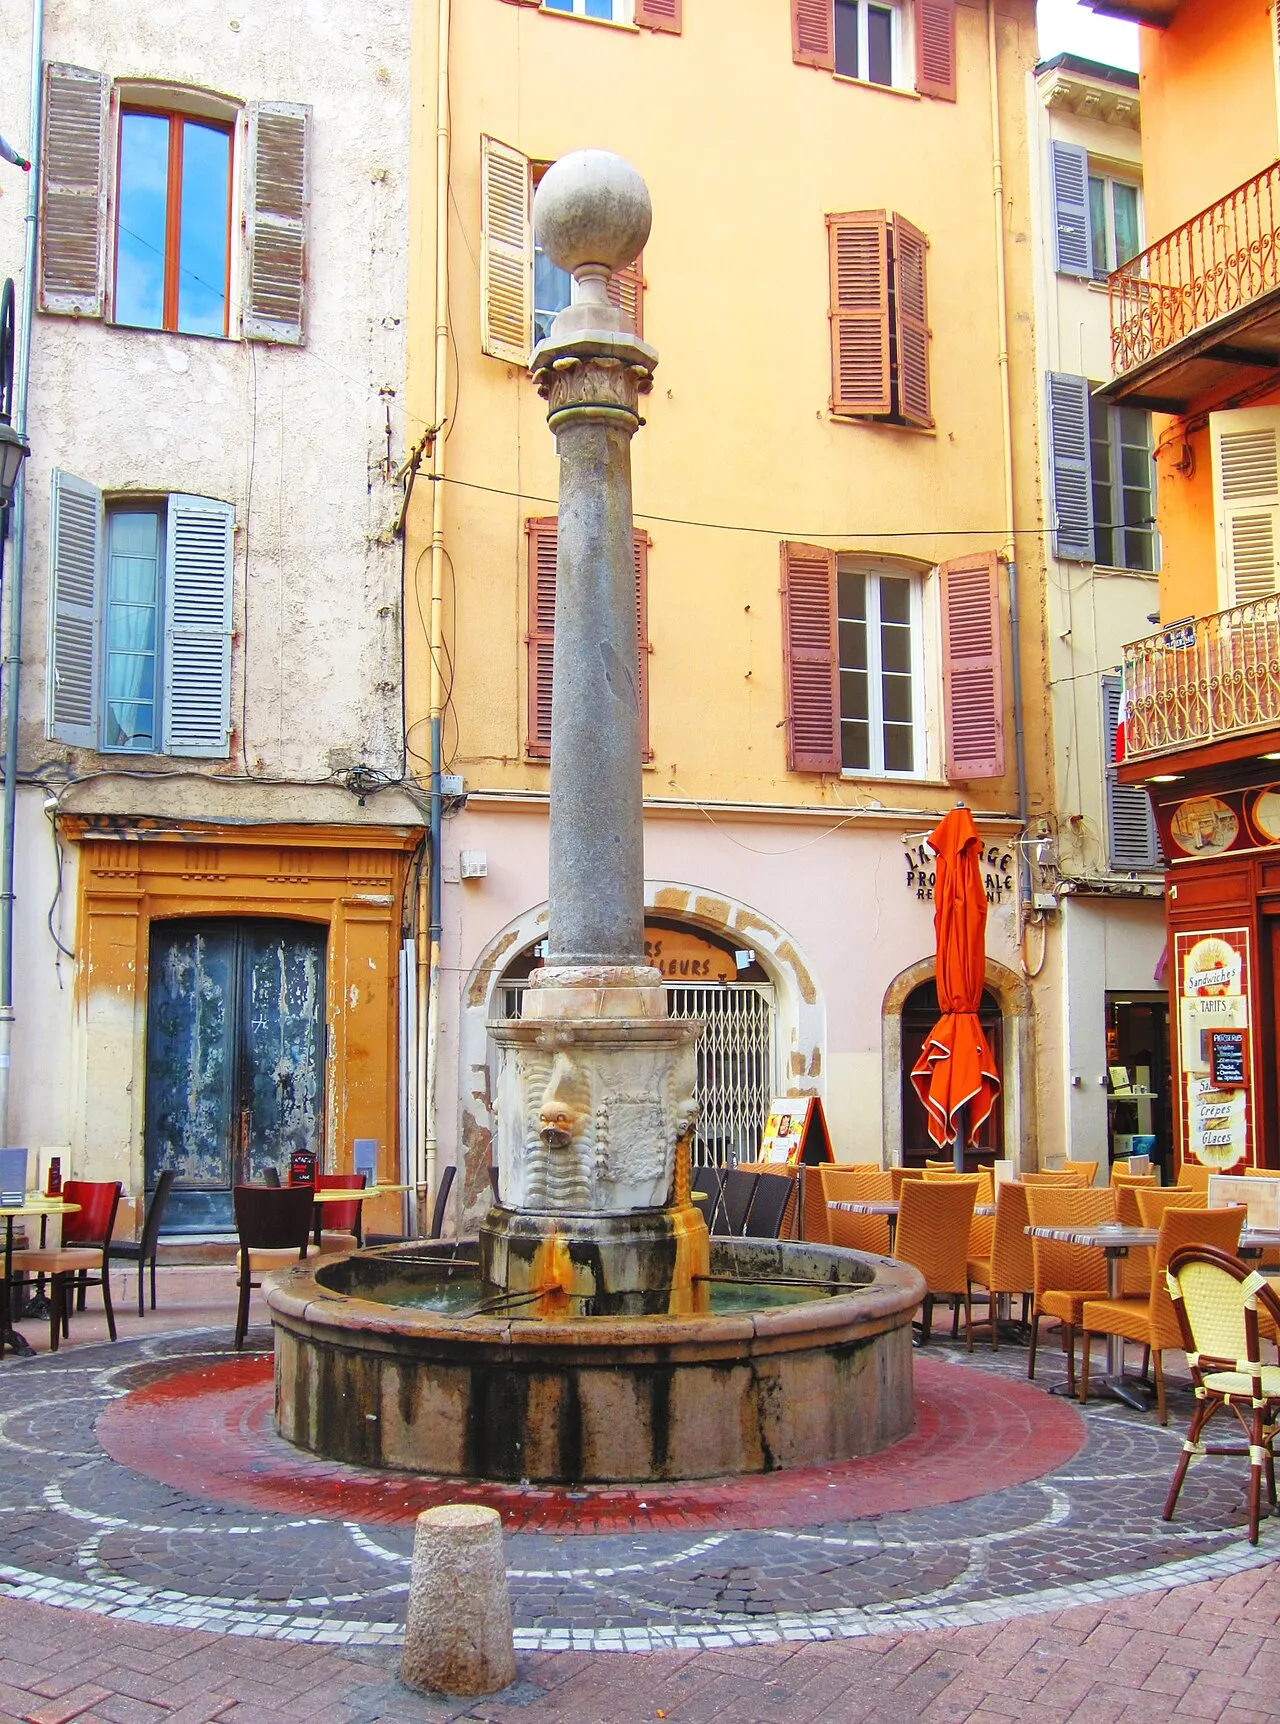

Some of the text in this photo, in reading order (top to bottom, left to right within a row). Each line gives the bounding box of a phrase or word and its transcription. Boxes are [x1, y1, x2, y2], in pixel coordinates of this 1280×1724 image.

[906, 871, 1013, 890] PROALE
[644, 941, 662, 957] RS
[650, 959, 710, 976] LEURS
[1189, 969, 1236, 988] Sandwiches
[1200, 1000, 1227, 1012] TARIFS
[1200, 1105, 1232, 1117] Crêpes
